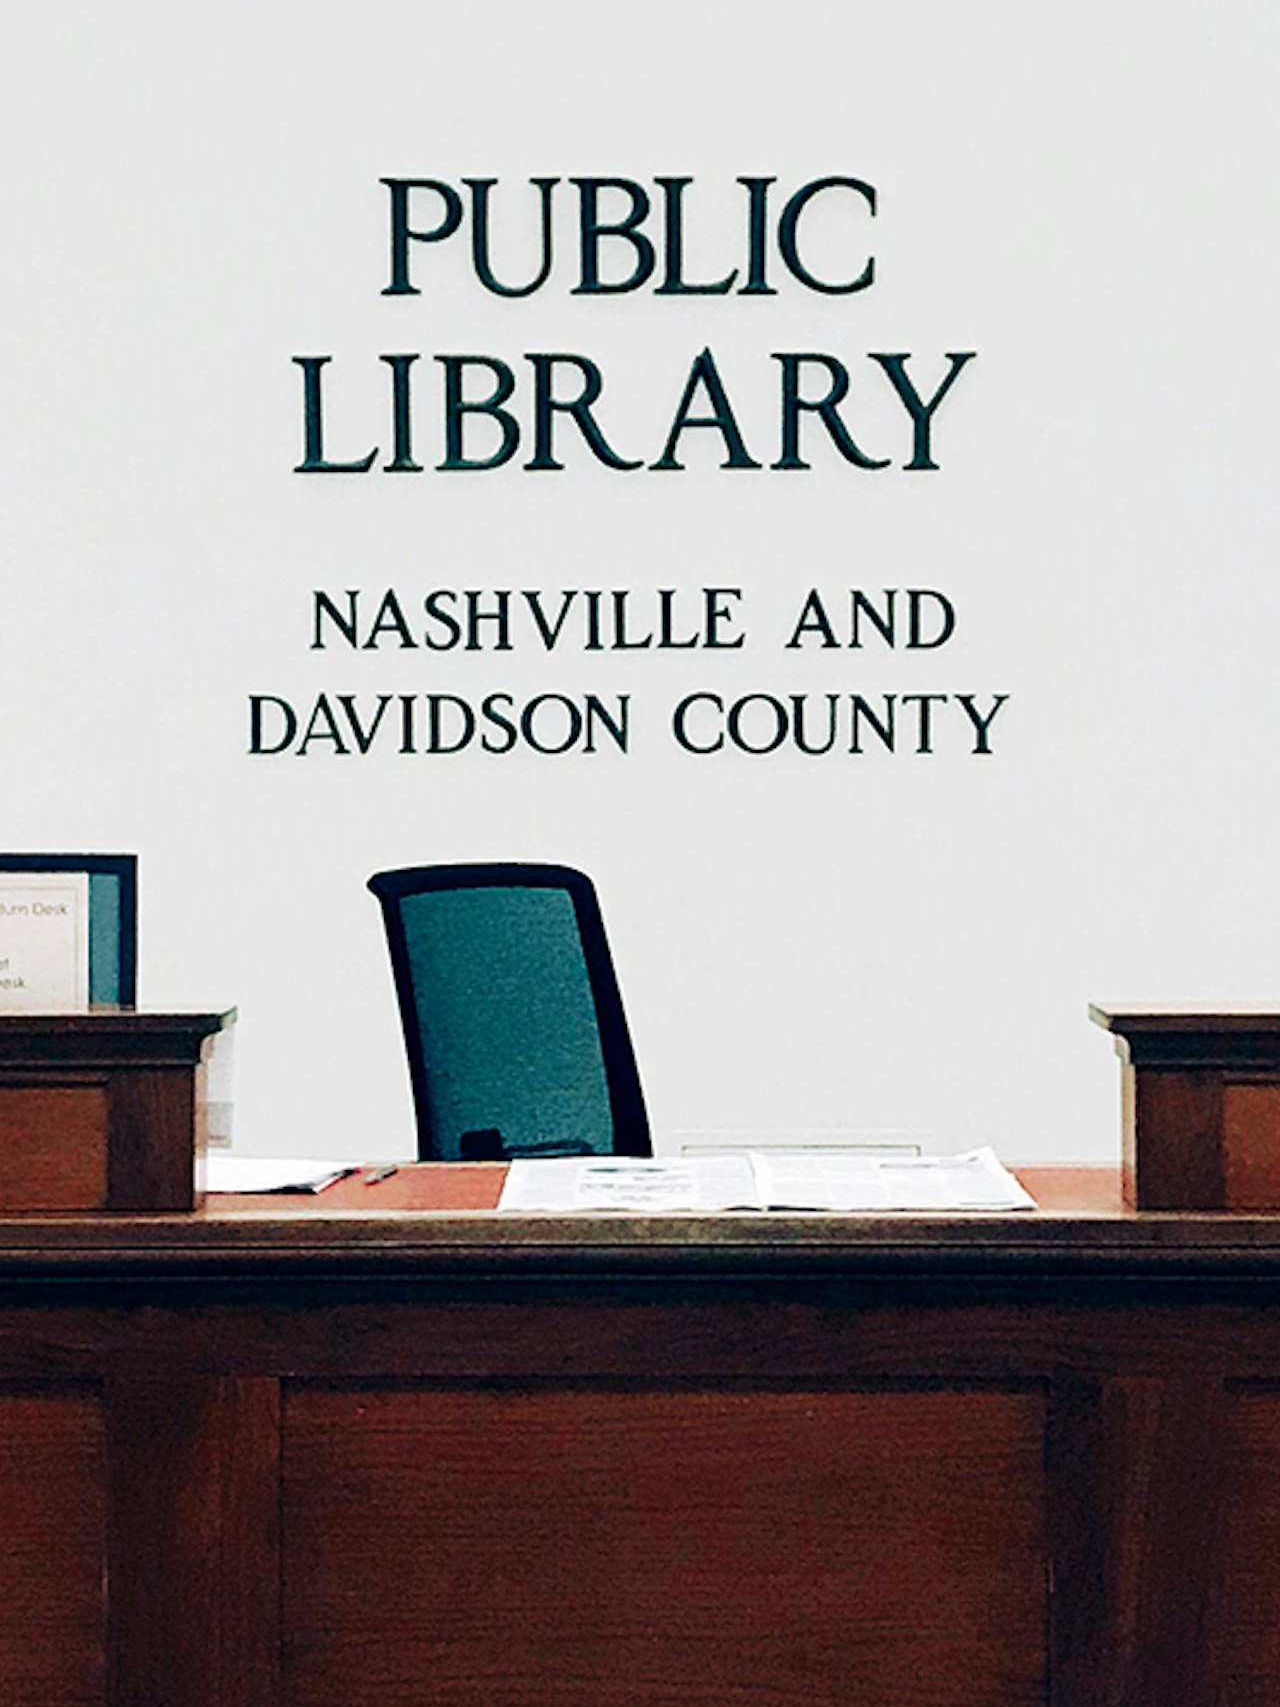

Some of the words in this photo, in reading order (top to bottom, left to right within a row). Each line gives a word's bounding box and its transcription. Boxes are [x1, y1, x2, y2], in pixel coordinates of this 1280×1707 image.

[378, 175, 877, 299] PUBLIC
[291, 346, 978, 474] LIBRARY
[310, 587, 746, 652] NASHVILLE
[784, 588, 956, 651] AND
[248, 692, 631, 757] DAVIDSON
[672, 692, 1010, 756] COUNTY
[32, 902, 68, 915] Desk
